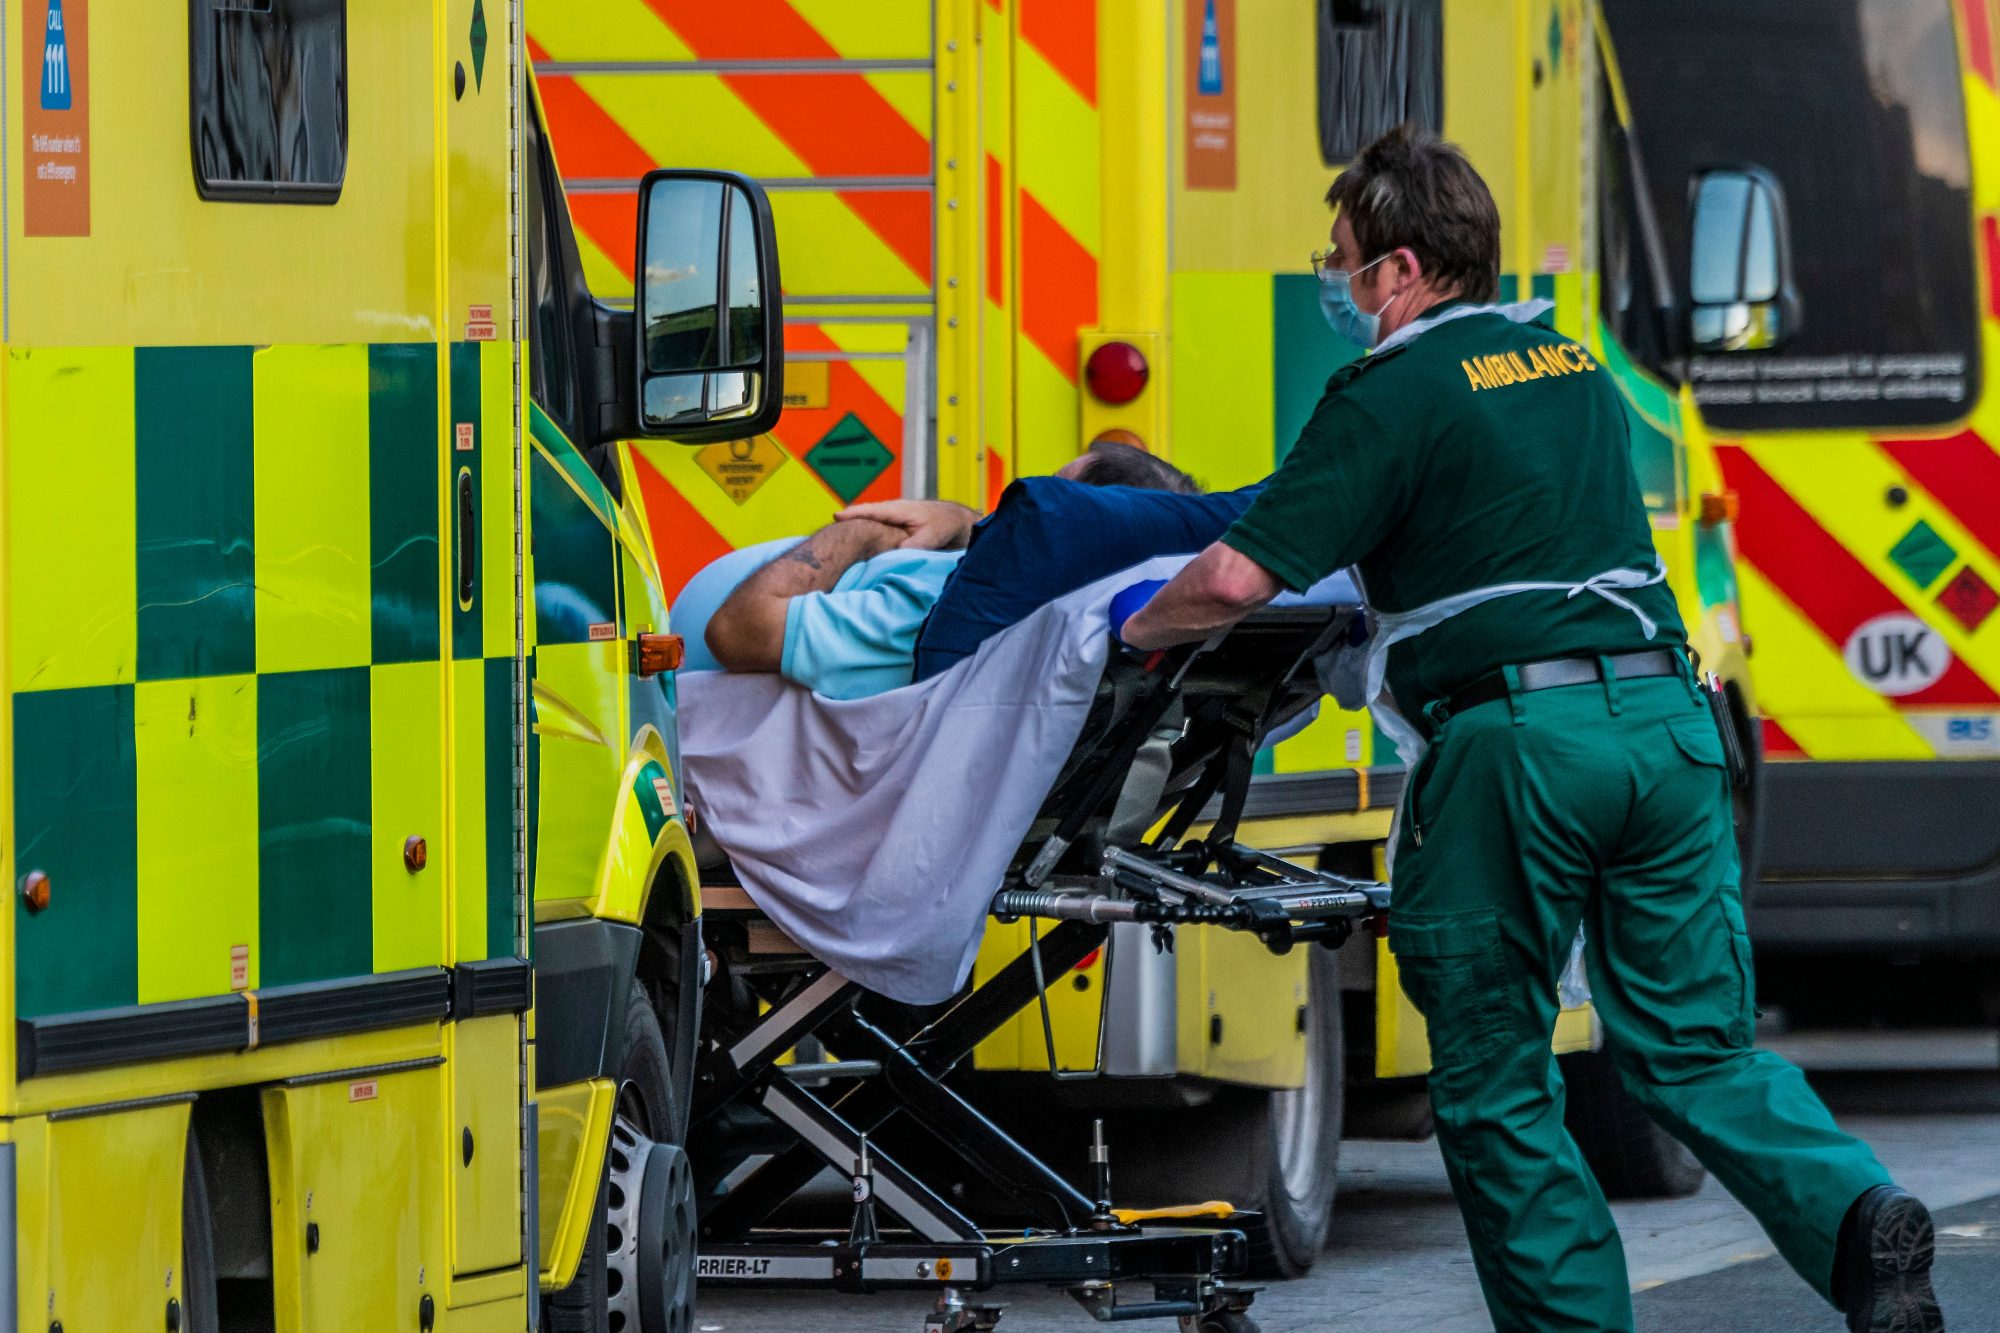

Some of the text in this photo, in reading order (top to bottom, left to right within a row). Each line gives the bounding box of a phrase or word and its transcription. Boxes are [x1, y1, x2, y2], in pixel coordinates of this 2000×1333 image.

[48, 10, 62, 31] CALL
[46, 44, 65, 94] 111
[1461, 342, 1597, 392] AMBULANCE
[1858, 631, 1933, 683] UK
